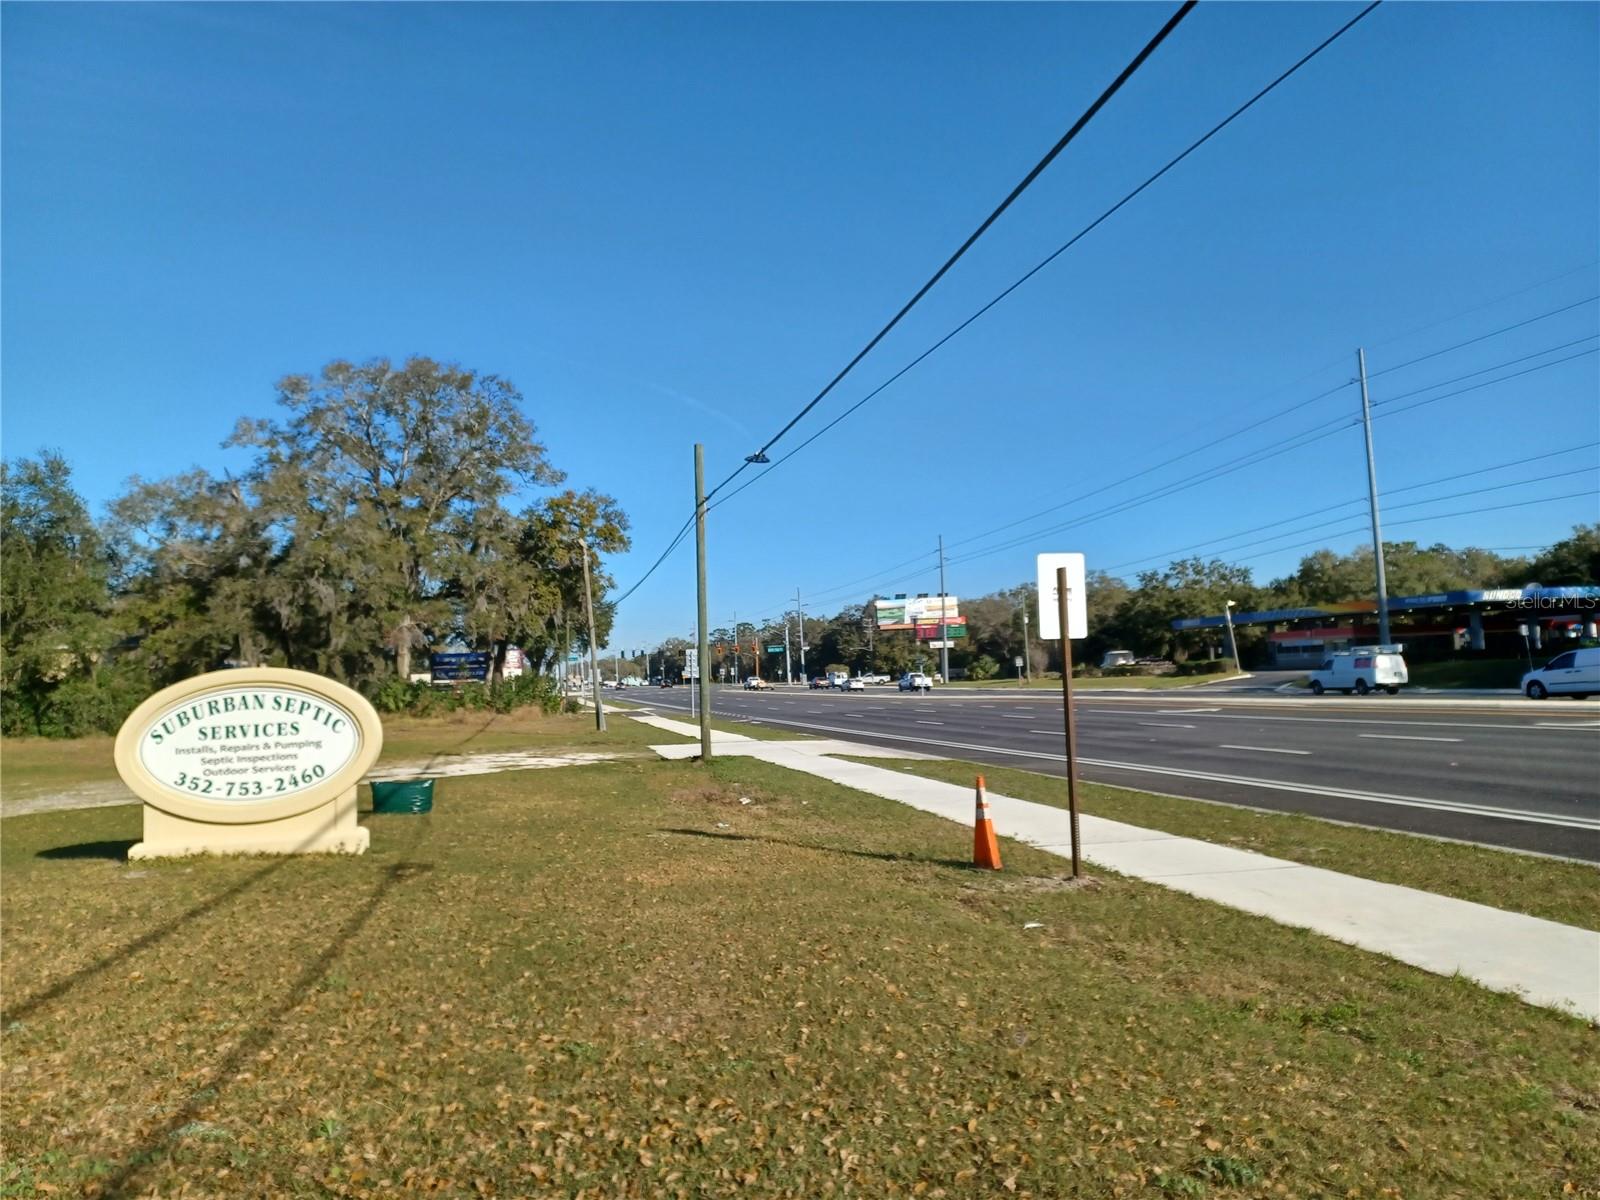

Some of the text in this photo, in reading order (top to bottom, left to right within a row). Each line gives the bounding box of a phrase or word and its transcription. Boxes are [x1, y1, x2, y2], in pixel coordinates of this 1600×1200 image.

[150, 694, 346, 745] SUBURBAN SEPTIC
[197, 721, 300, 741] SERVICES
[175, 740, 323, 755] Installs, Repairs & Pumping
[200, 752, 298, 766] Septic Inspections
[202, 764, 296, 777] Outdoor Services
[174, 764, 325, 796] 352-753-2460
